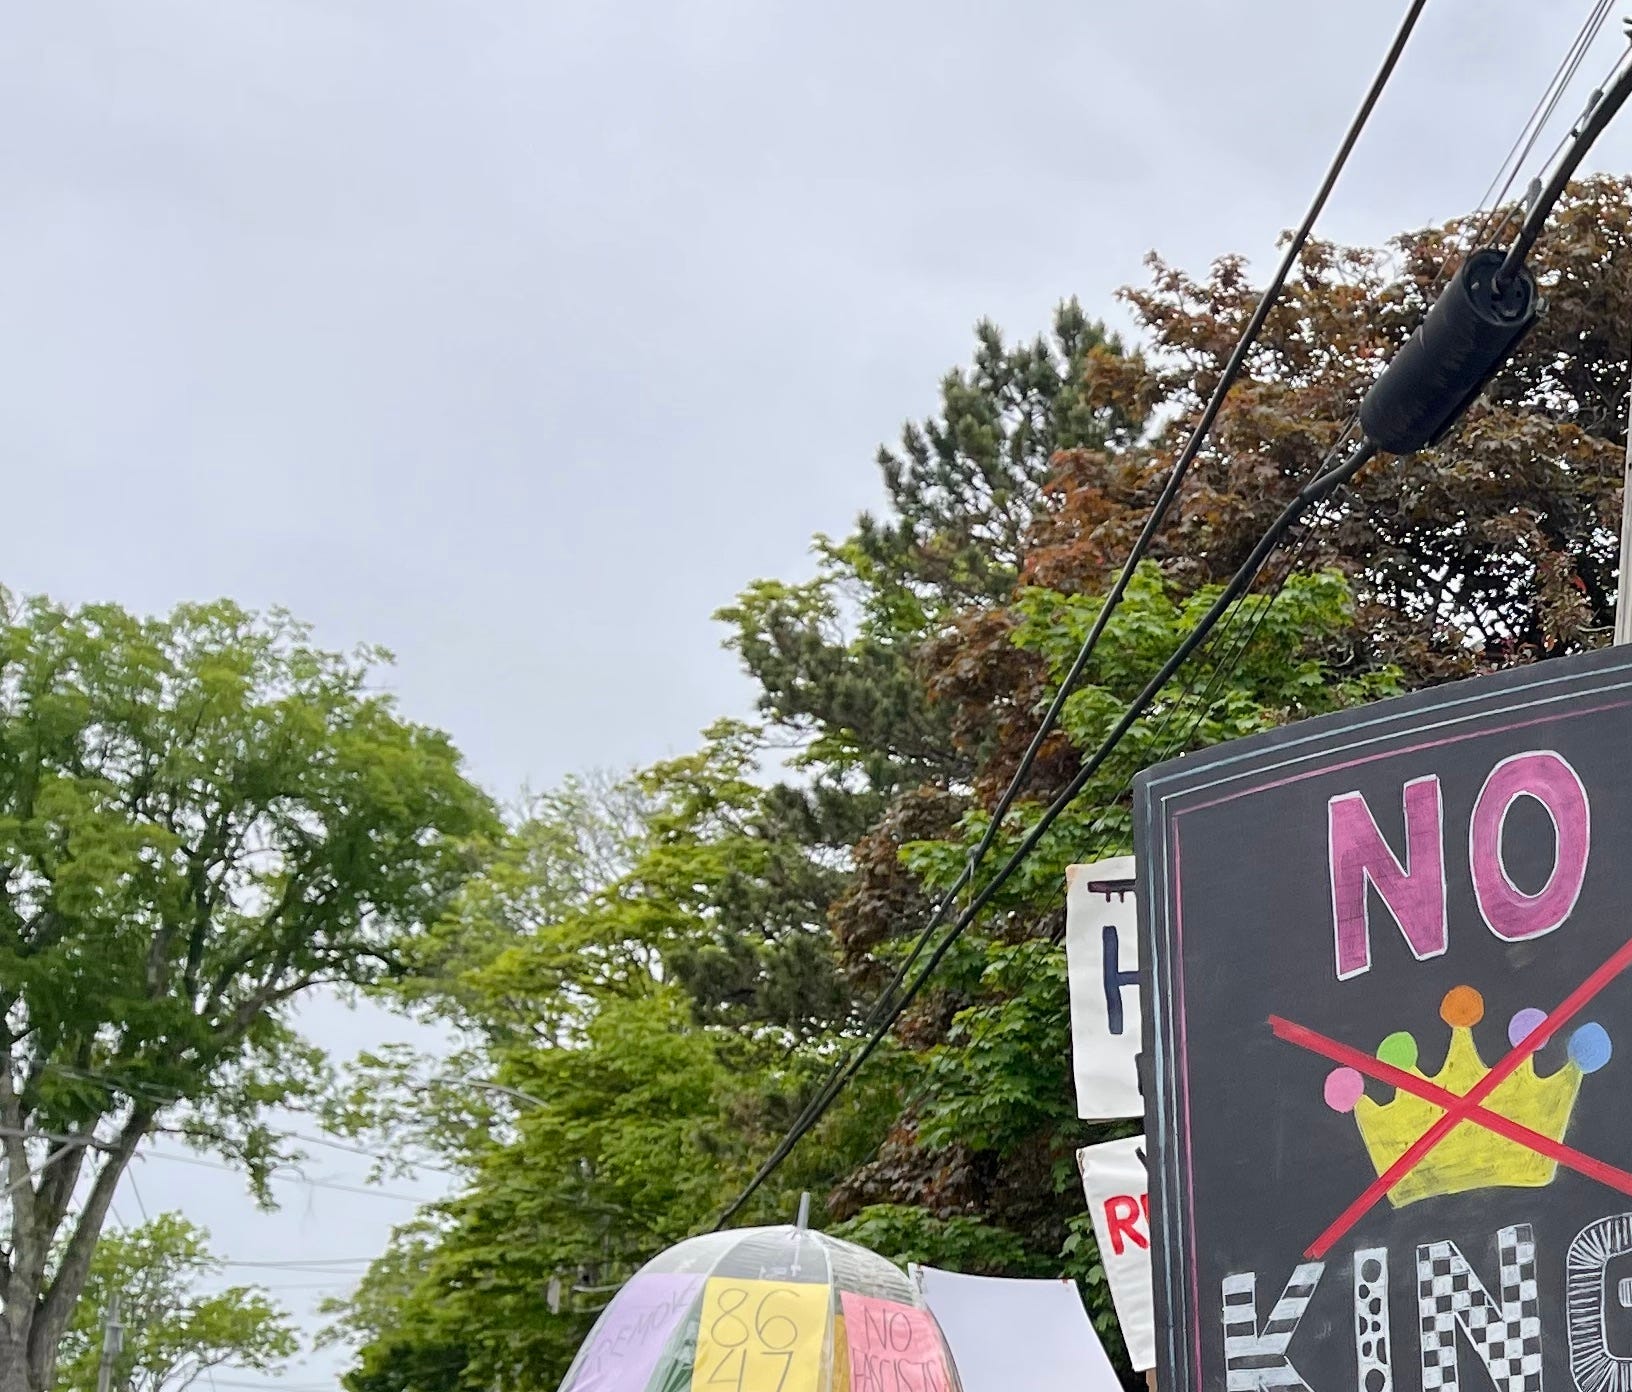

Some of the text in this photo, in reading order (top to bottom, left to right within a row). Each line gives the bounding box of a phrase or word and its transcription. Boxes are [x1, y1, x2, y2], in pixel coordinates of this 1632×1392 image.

[1327, 749, 1592, 982] NO
[710, 1287, 801, 1350] 86
[864, 1305, 912, 1352] NO
